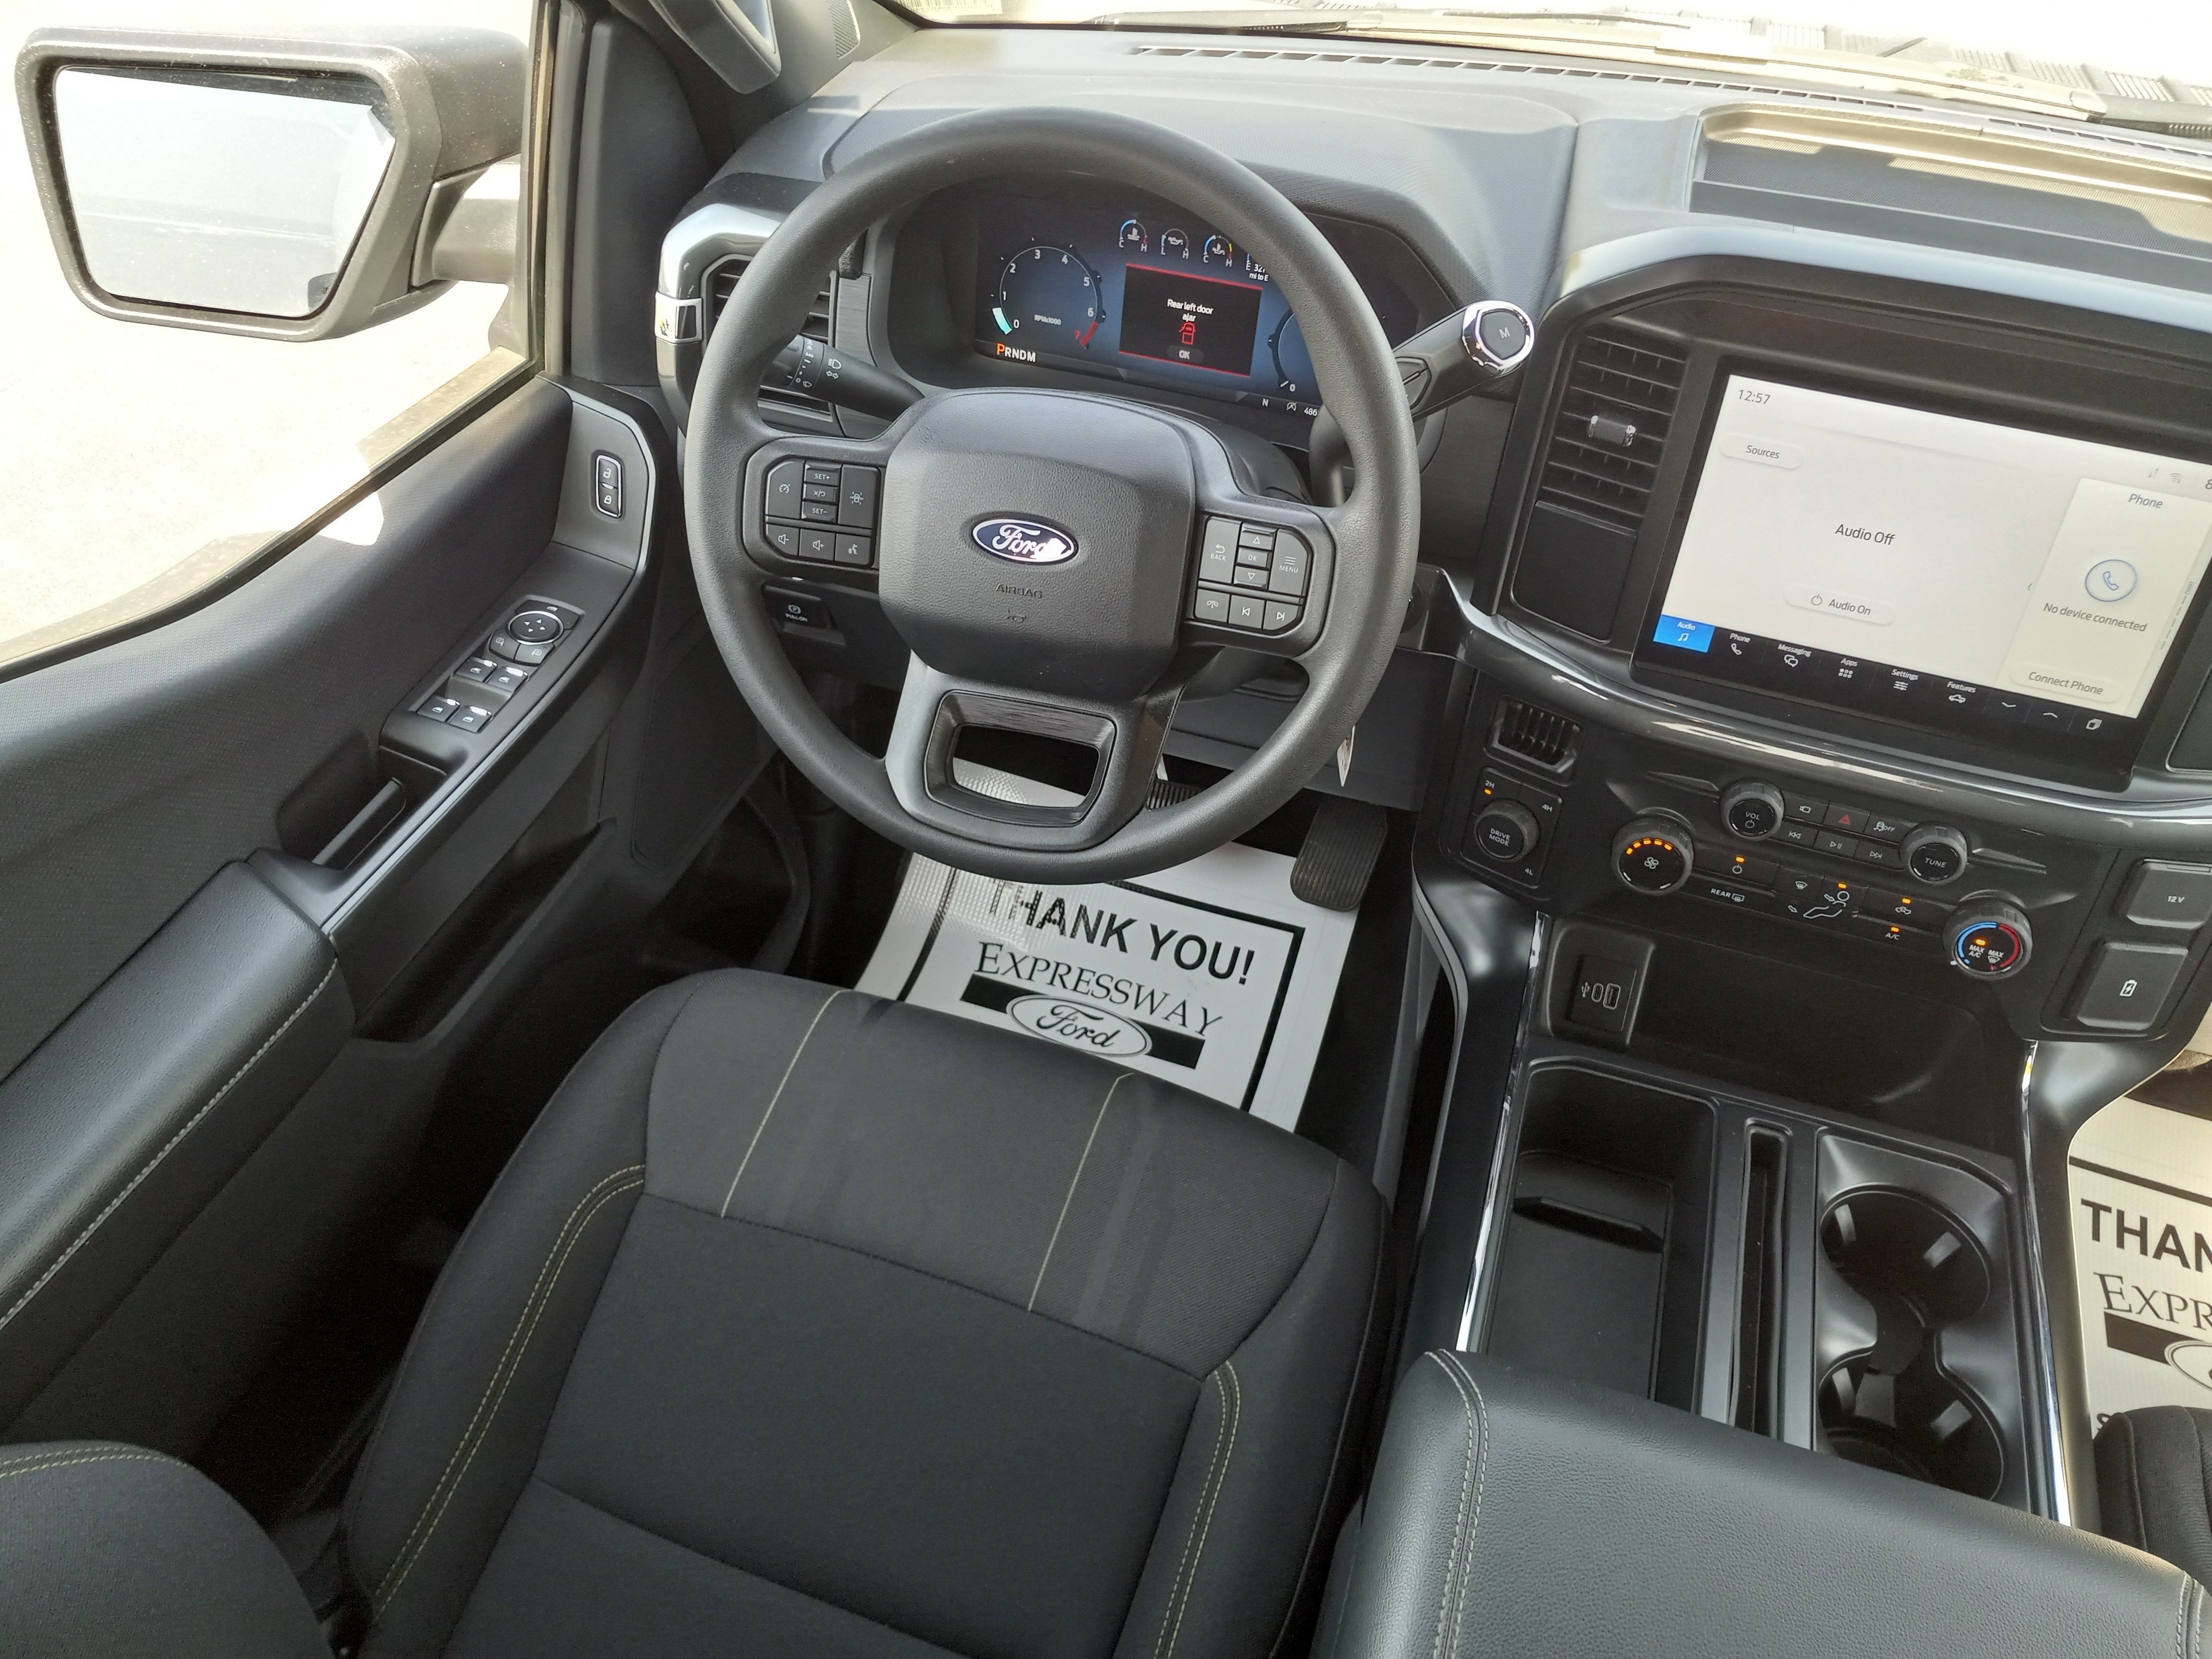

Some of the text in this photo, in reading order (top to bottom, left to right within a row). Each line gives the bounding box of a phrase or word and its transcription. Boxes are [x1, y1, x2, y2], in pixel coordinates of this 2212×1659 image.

[1141, 244, 1147, 252] H
[1034, 249, 1041, 259] 3
[1061, 254, 1069, 264] 4
[1182, 251, 1189, 259] H
[1203, 255, 1209, 263] C
[1010, 263, 1016, 273] 2
[1226, 259, 1232, 267] H
[1083, 276, 1090, 287] 5
[1003, 291, 1007, 301] 1
[1167, 299, 1214, 314] Rear left door
[1087, 307, 1094, 317] 6
[1182, 313, 1196, 322] ajar
[1013, 319, 1020, 329] 0
[1499, 327, 1510, 338] M
[997, 343, 1036, 362] PRNDM
[1178, 350, 1190, 360] OK
[1289, 384, 1296, 392] 0
[1737, 389, 1770, 405] 12:57
[1262, 398, 1269, 407] N
[1745, 445, 1780, 459] Sources
[2128, 493, 2163, 509] Phone
[1835, 524, 1896, 546] Audio Off
[1210, 553, 1226, 561] BACK
[1279, 565, 1298, 573] MENU
[995, 583, 1043, 599] AIRBAG
[1828, 599, 1871, 615] Audio On
[2043, 602, 2148, 632] No device connected
[1677, 621, 1695, 631] Audio
[1730, 632, 1751, 643] Phone
[1778, 643, 1812, 658] Messaging
[1840, 657, 1858, 667] Apps
[1891, 668, 1919, 681] Settings
[1947, 681, 1976, 694] Features
[2029, 672, 2104, 696] Connect Phone
[1485, 779, 1495, 789] 2H
[1542, 804, 1552, 813] 4H
[1745, 811, 1760, 821] VOL
[1489, 833, 1510, 847] MODE
[1490, 828, 1511, 842] DRIVE
[1924, 857, 1947, 868] TUNE
[1525, 867, 1533, 876] 4L
[1711, 888, 1731, 898] REAR
[1885, 932, 1901, 941] A/C
[1969, 944, 1985, 954] MAX
[1987, 950, 2005, 958] MAX
[1149, 923, 1255, 986] YOU!
[1969, 950, 1982, 959] A/C
[974, 941, 1224, 1037] EXPRESSWAY
[1036, 1004, 1121, 1048] Ford
